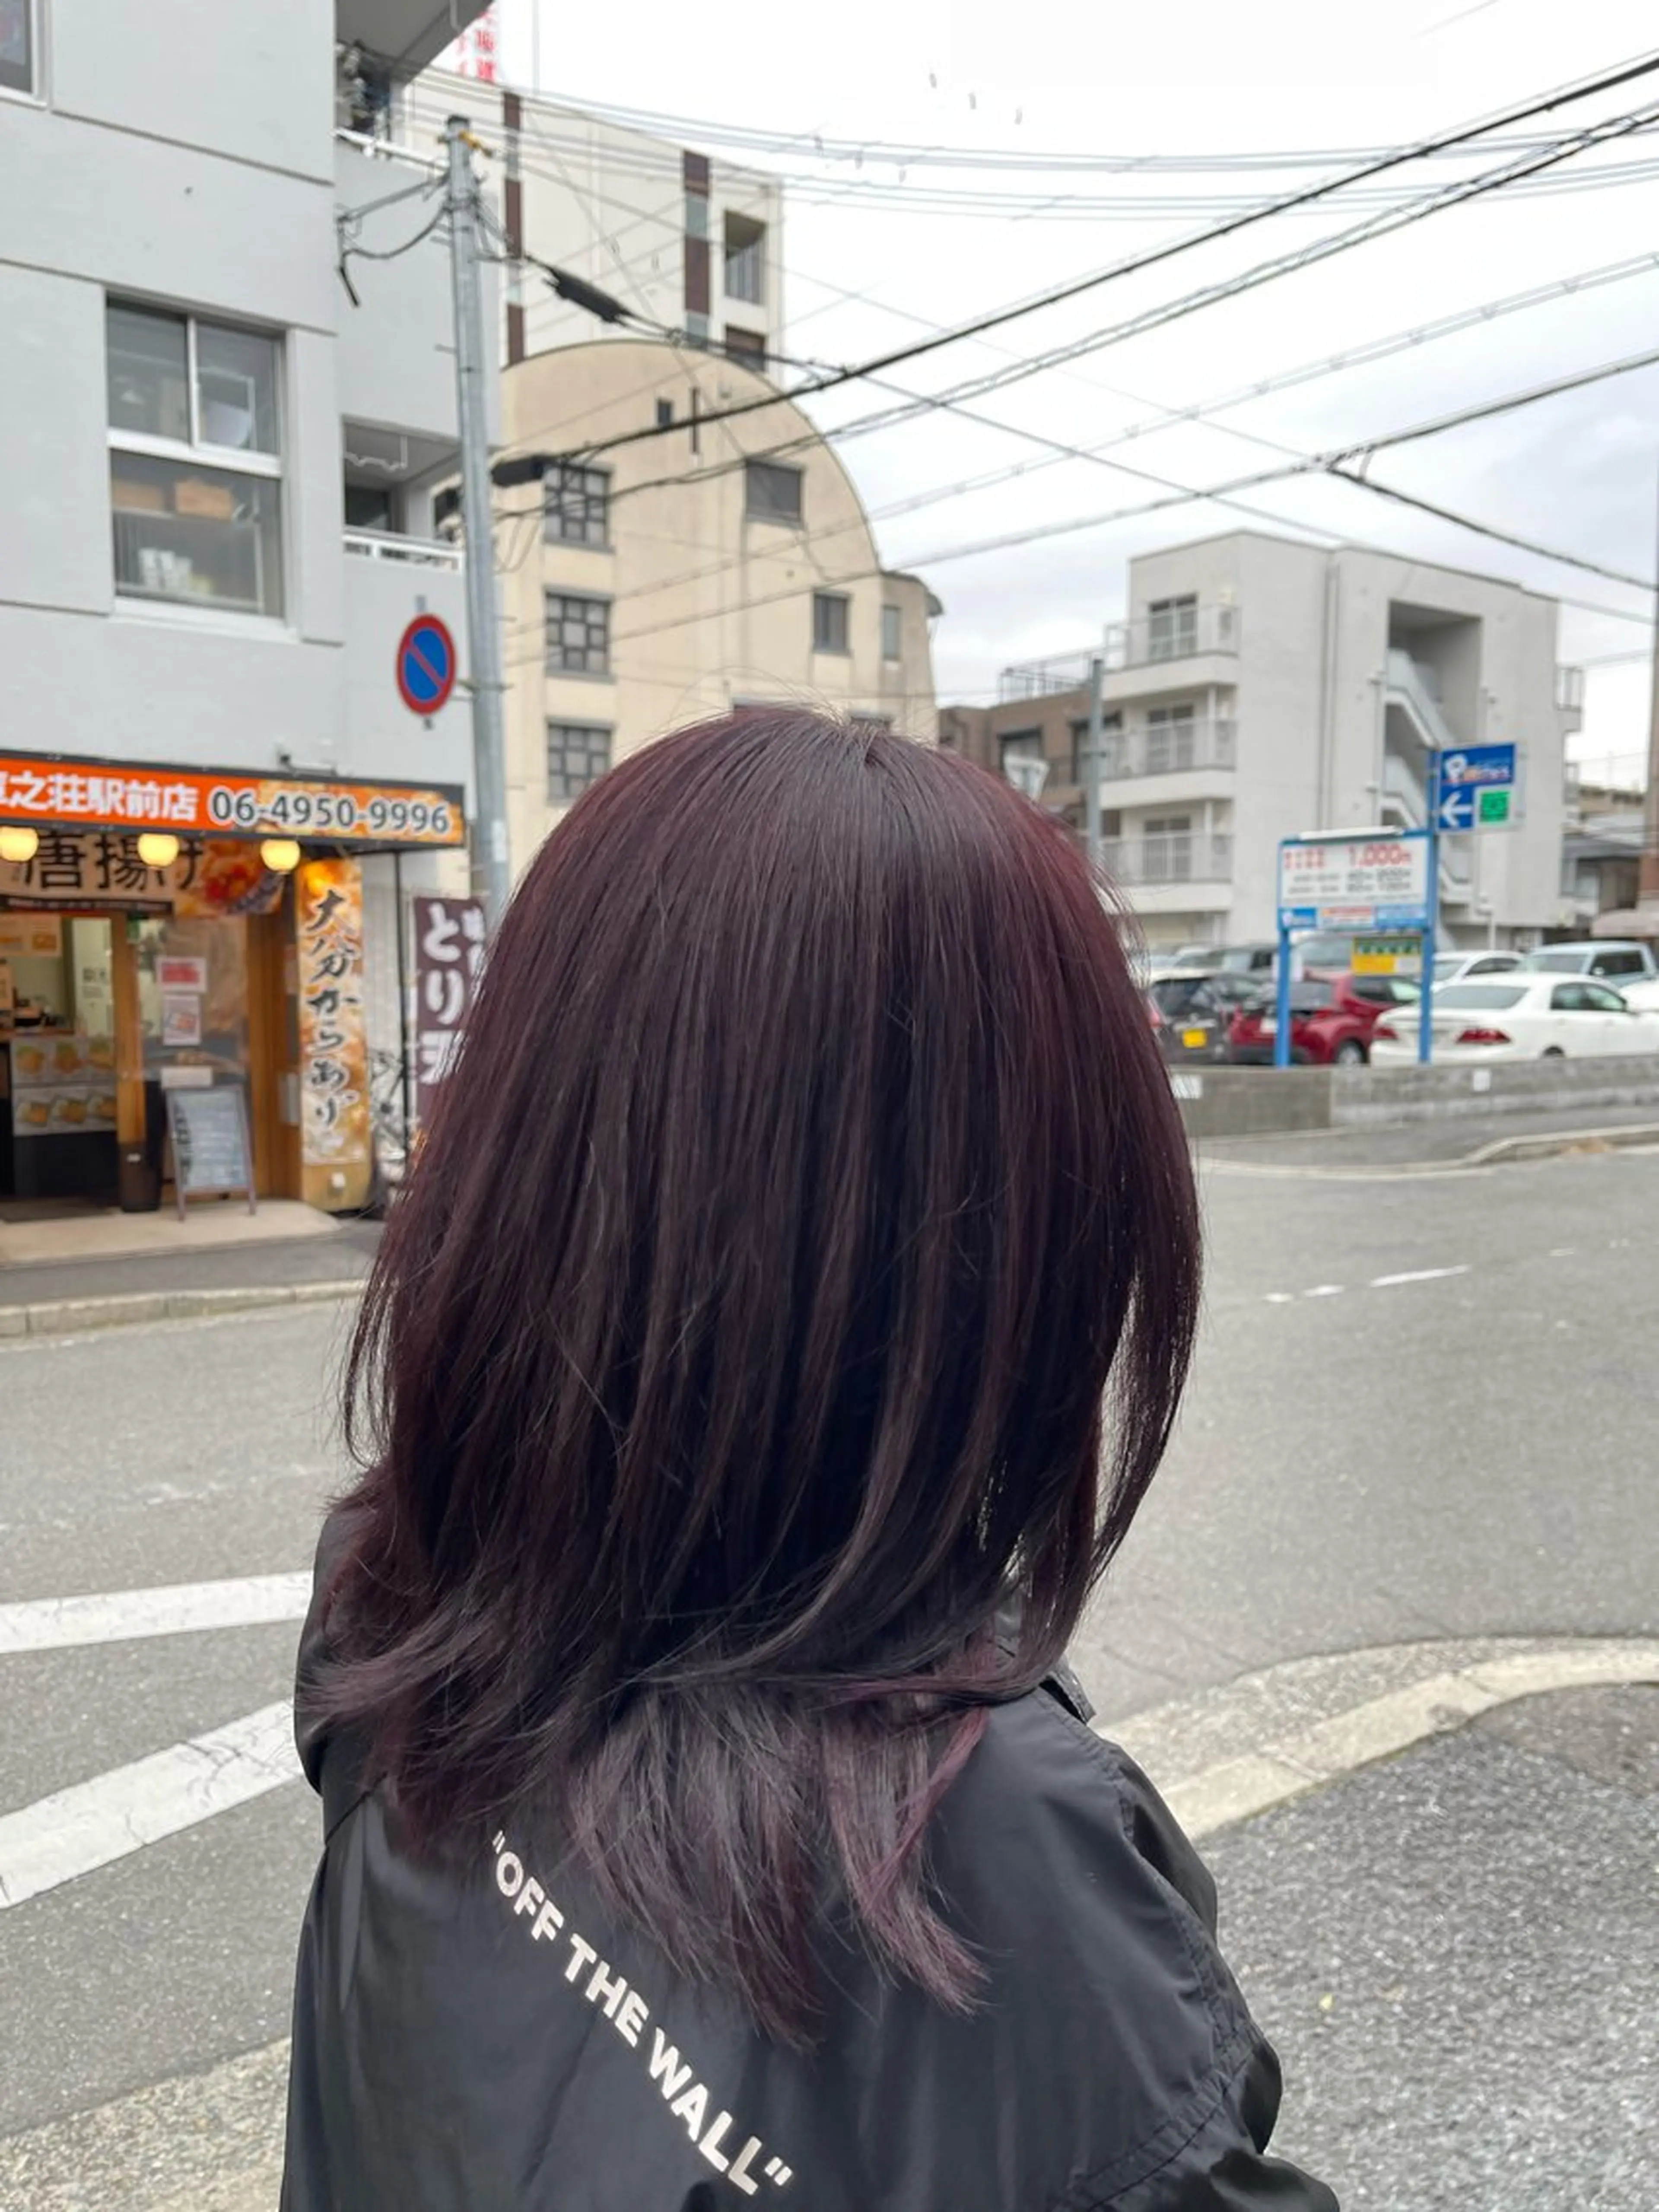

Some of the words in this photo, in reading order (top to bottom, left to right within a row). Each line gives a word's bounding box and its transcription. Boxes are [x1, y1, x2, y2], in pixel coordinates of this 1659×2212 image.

[0, 770, 200, 822] 之荘駅前店
[210, 790, 451, 835] 06-4950-9996
[564, 1933, 649, 2047] THE
